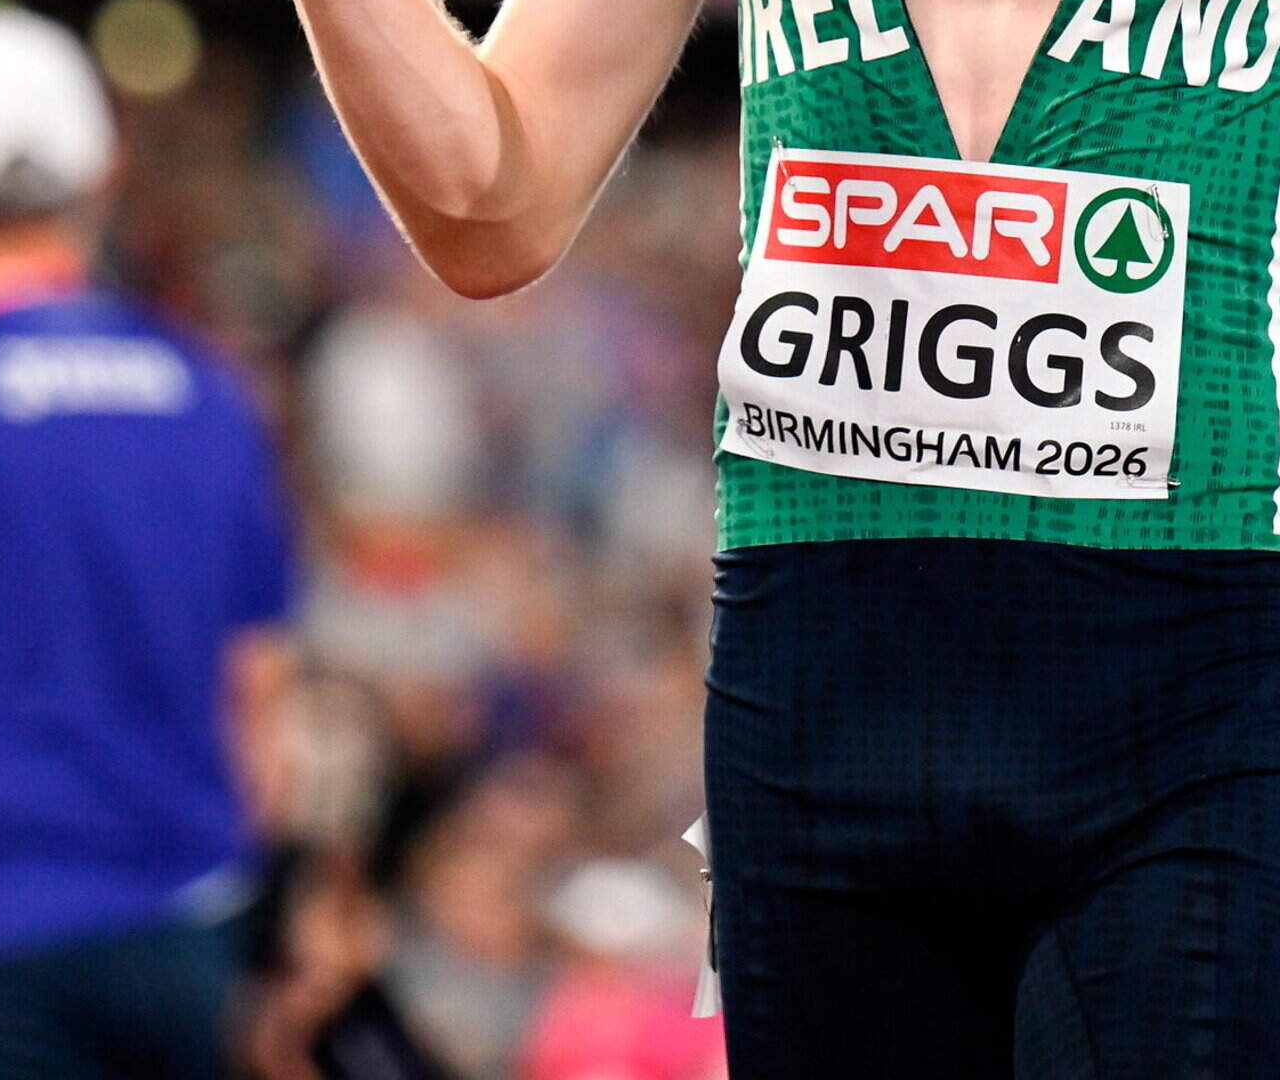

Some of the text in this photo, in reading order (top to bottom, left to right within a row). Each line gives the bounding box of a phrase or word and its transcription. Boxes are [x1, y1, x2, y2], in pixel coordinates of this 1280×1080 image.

[776, 176, 1053, 267] SPAR
[740, 291, 1156, 412] GRIGGS
[743, 402, 1148, 477] BIRMINGHAM 2026
